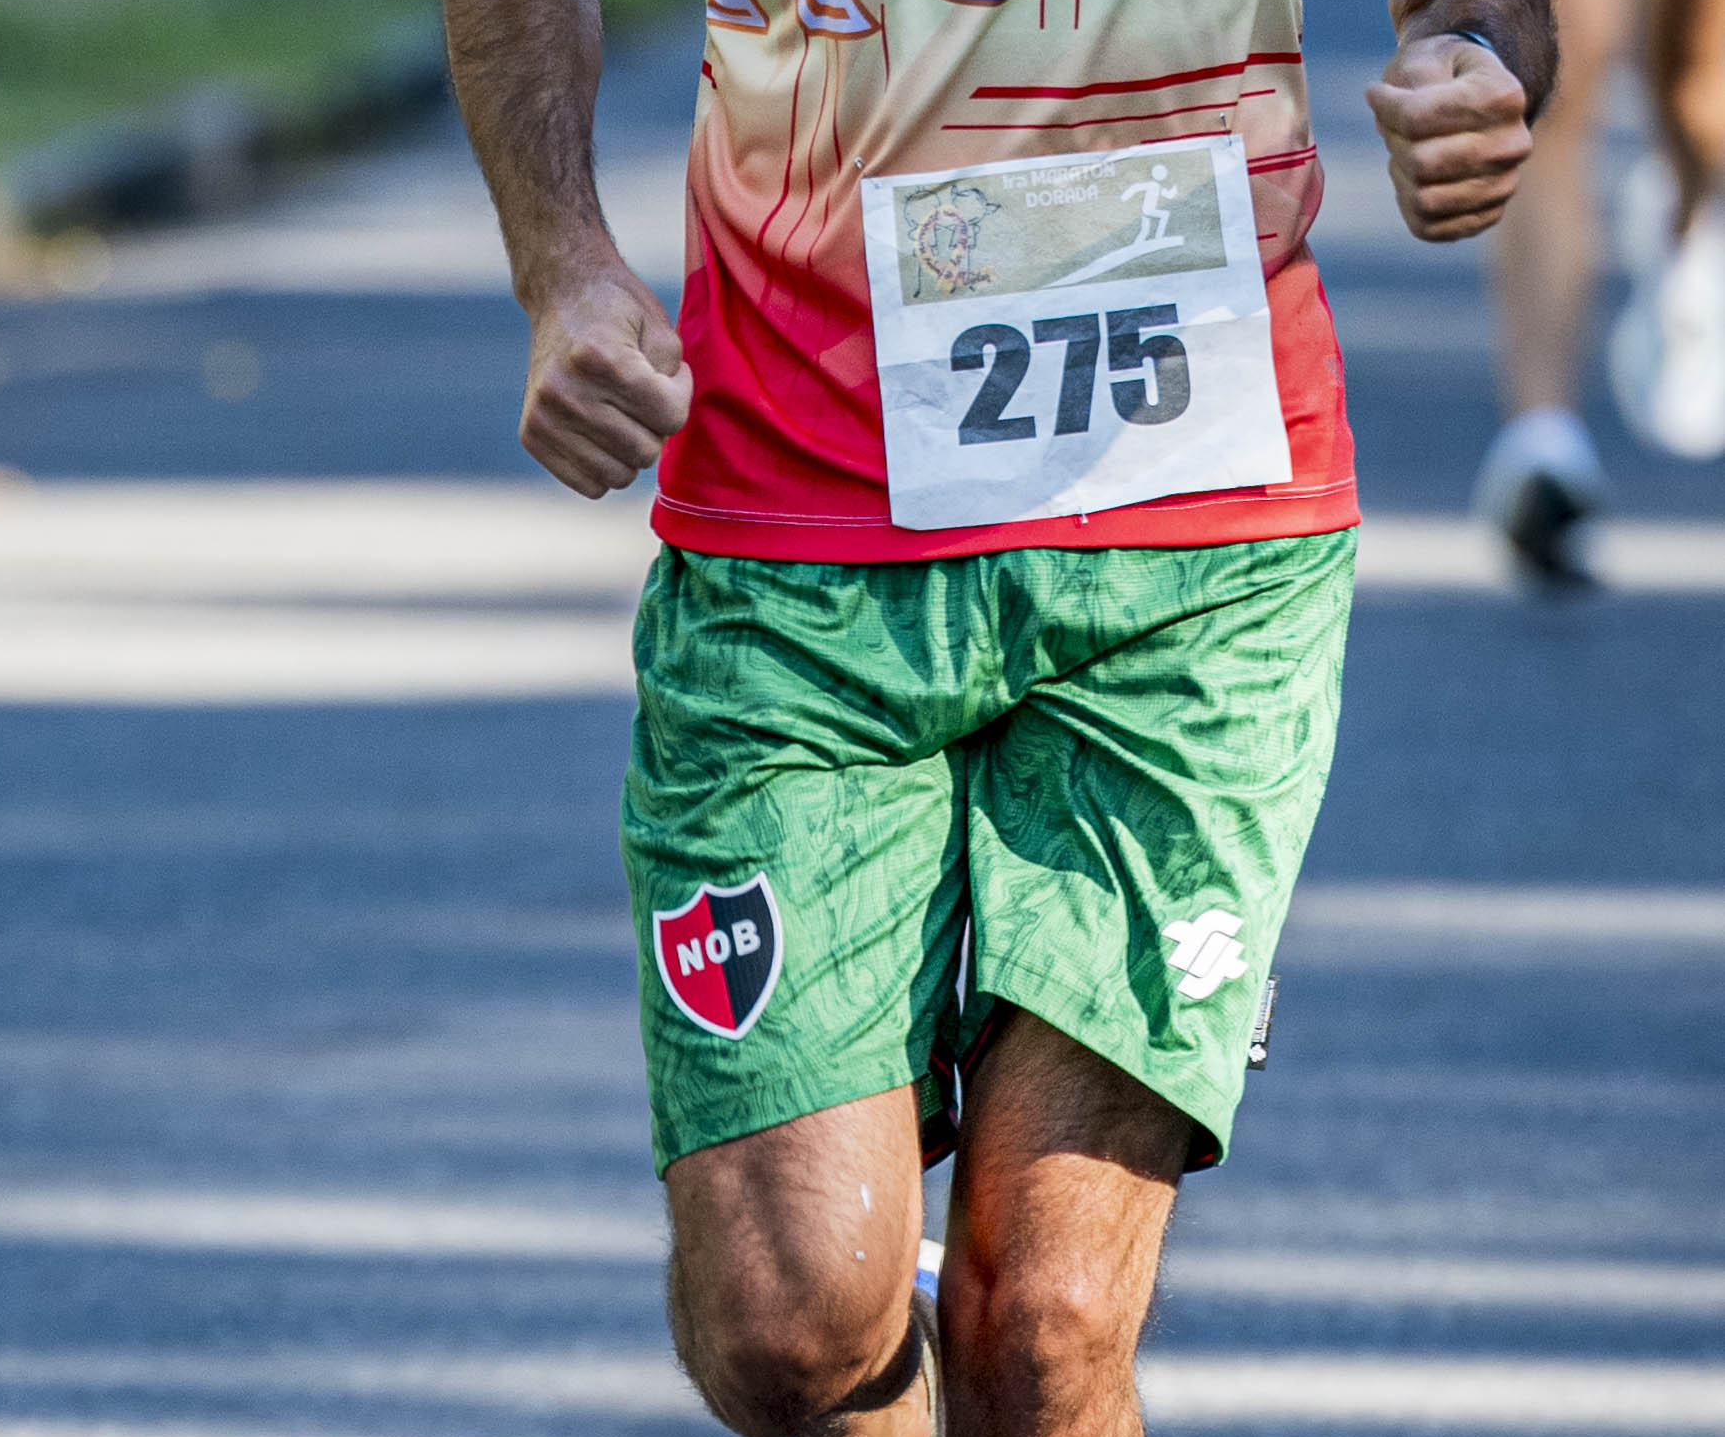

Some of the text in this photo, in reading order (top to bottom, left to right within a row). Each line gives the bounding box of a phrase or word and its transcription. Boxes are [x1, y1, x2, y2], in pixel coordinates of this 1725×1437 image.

[1025, 184, 1099, 208] DORADA
[951, 304, 1190, 446] 275
[676, 920, 761, 976] NOB
